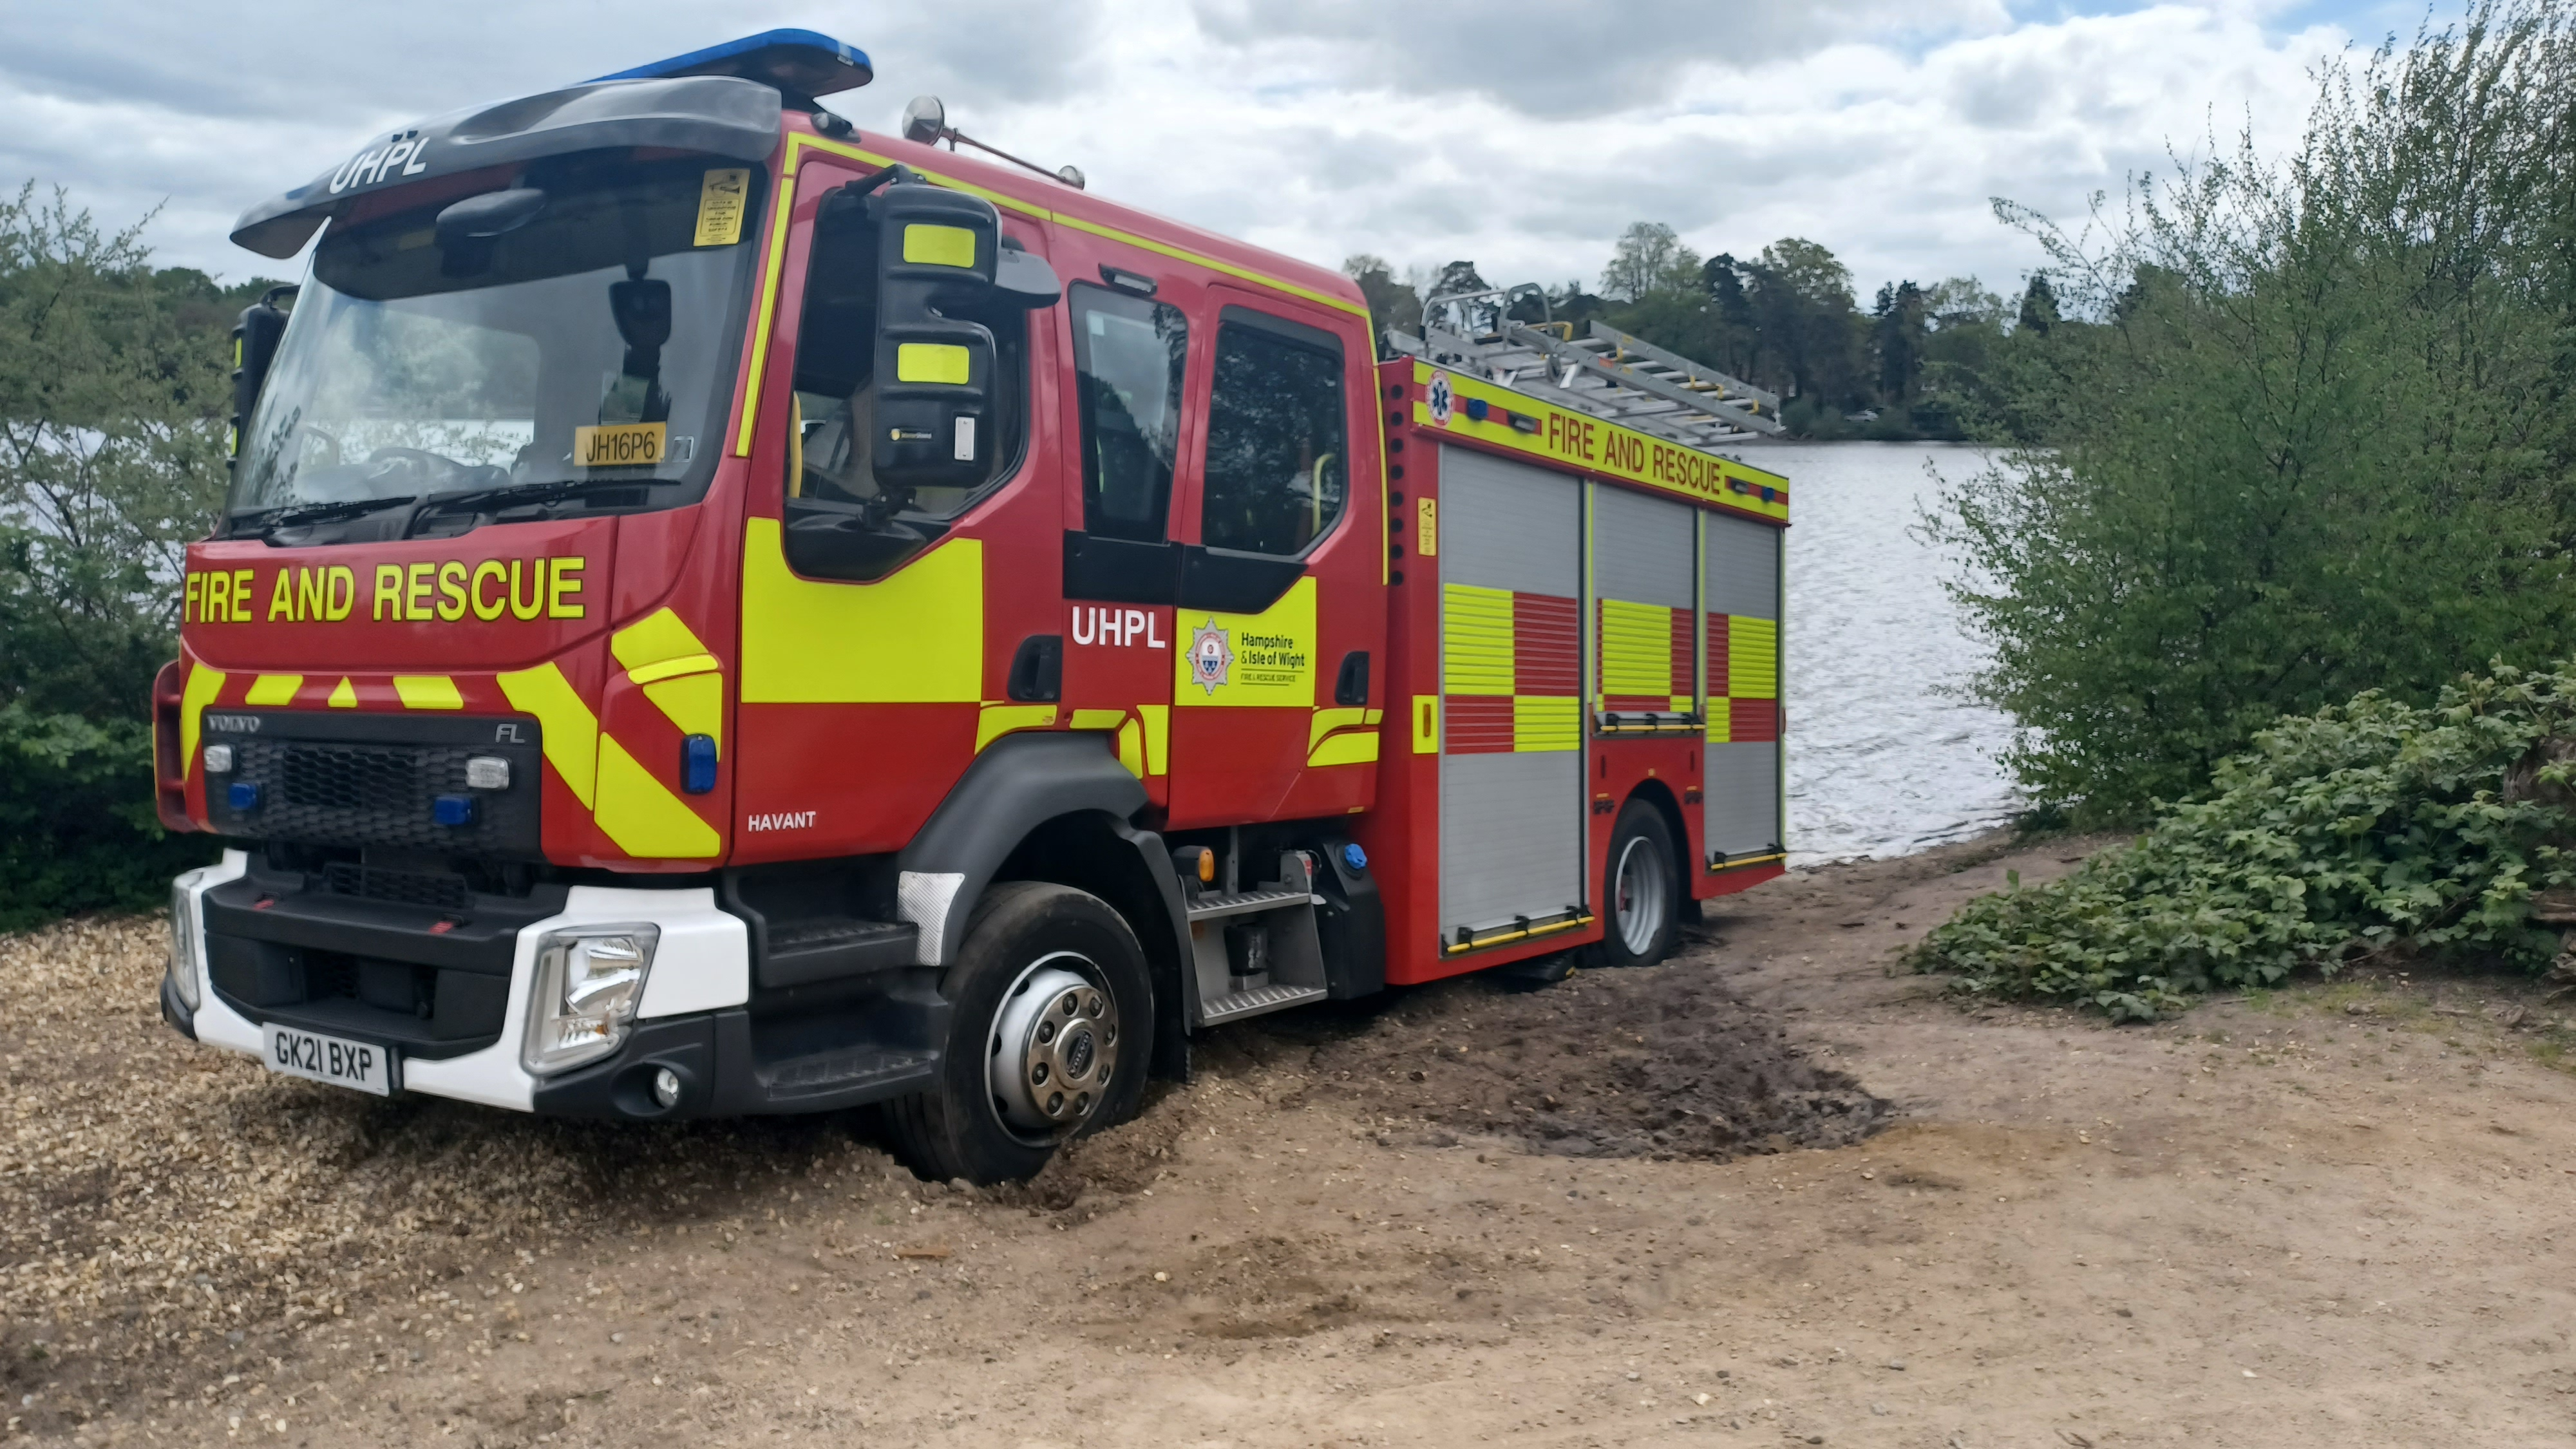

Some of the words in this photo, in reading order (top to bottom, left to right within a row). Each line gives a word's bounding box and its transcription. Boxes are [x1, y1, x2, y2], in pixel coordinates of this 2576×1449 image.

[330, 137, 430, 194] UHPL
[1549, 412, 1594, 461] FIRE
[1604, 430, 1645, 473] AND
[1653, 444, 1720, 495] RESCUE
[185, 568, 254, 623] FIRE
[267, 564, 354, 622] AND
[372, 556, 585, 622] RESCUE
[1072, 605, 1166, 649] UHPL
[1241, 632, 1294, 650] Hampshire
[1240, 650, 1247, 665] &
[1249, 650, 1265, 665] Isle
[1267, 651, 1277, 665] of
[1278, 652, 1305, 669] Wight
[207, 715, 260, 733] VOLVO
[495, 723, 526, 743] FL
[748, 811, 816, 832] HAVANT
[276, 1031, 323, 1073] GK21
[328, 1040, 372, 1081] BXP
